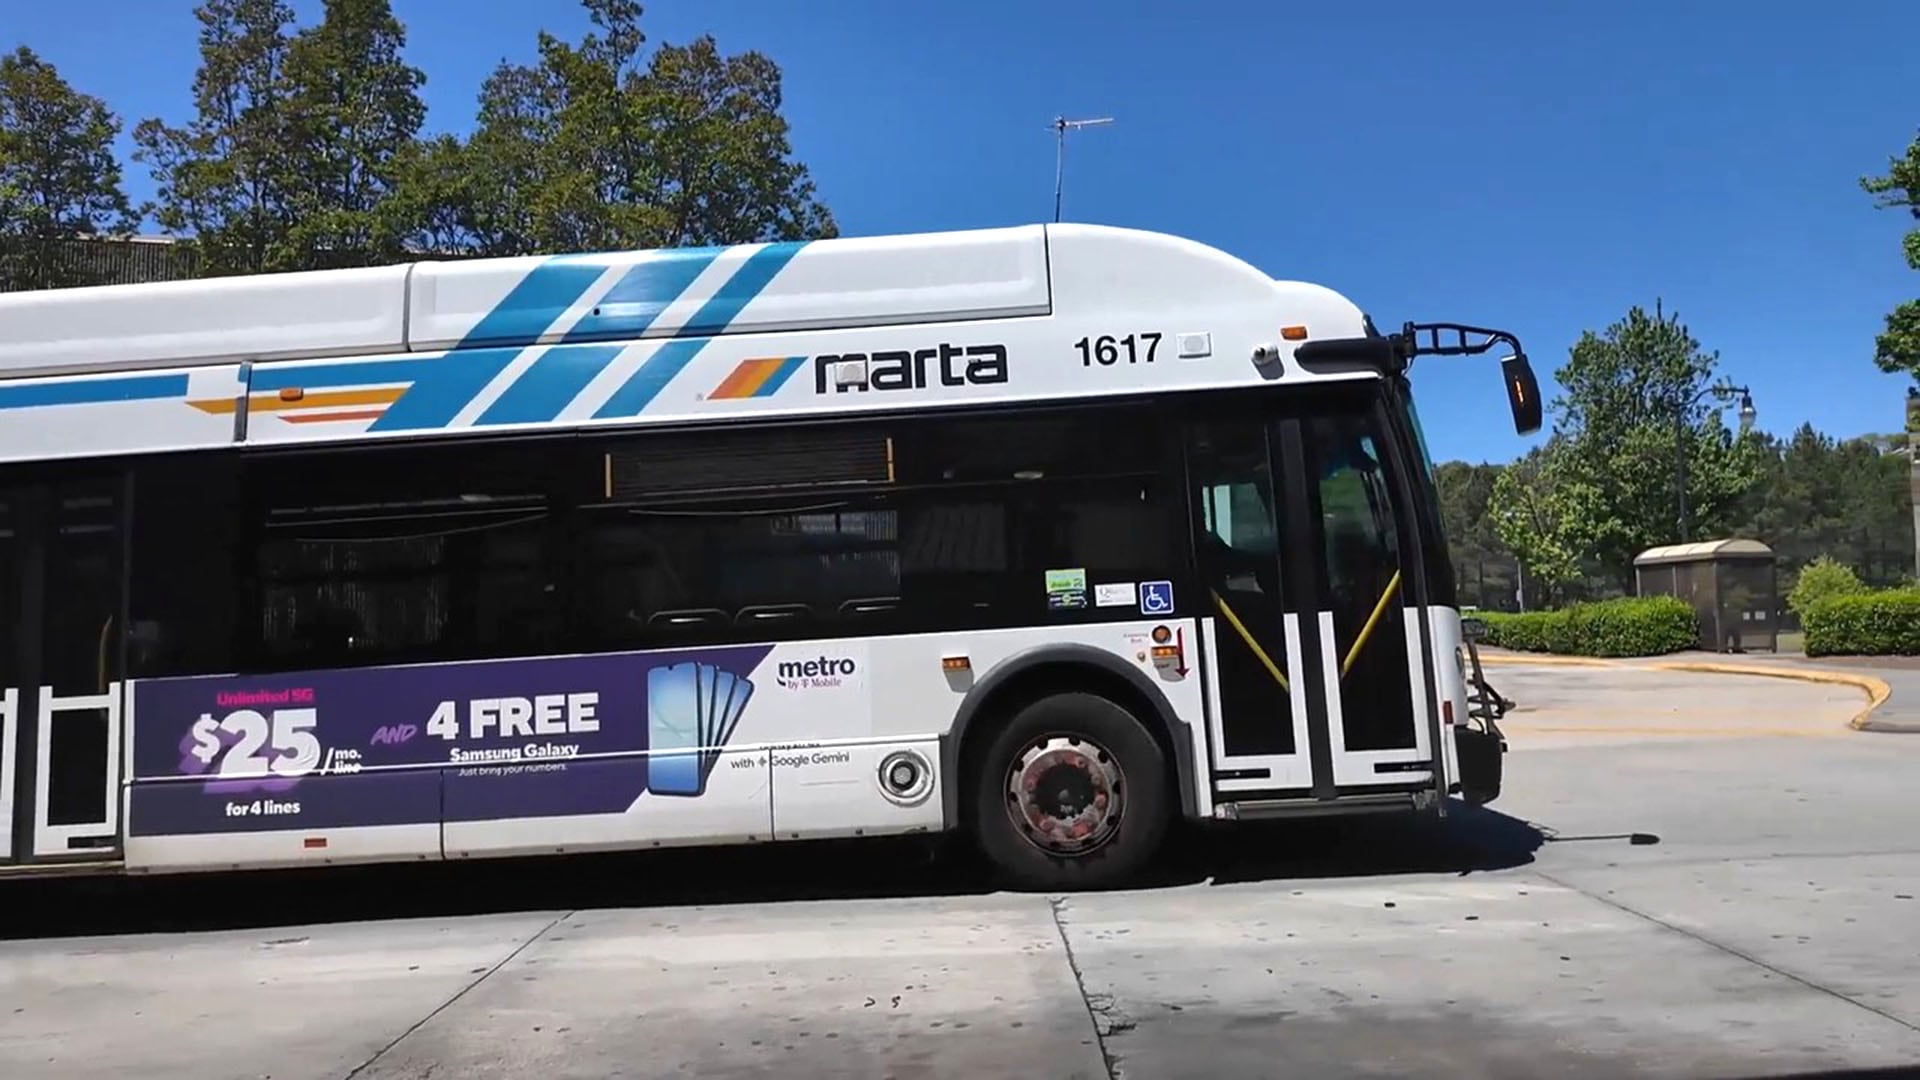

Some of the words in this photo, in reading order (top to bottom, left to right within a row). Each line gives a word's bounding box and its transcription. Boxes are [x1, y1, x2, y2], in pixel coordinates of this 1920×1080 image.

[1074, 332, 1163, 367] 1617
[814, 343, 1009, 394] marta
[778, 656, 855, 678] metro
[788, 680, 799, 691] by
[217, 689, 289, 705] Unlimited
[291, 688, 314, 701] 5G
[426, 700, 459, 740] 4
[469, 692, 600, 739] FREE
[370, 723, 418, 746] AND
[450, 747, 522, 763] Samsung
[524, 743, 579, 760] Galaxy
[730, 757, 755, 769] with
[771, 754, 809, 768] Google
[811, 751, 850, 765] Gemini
[458, 767, 478, 777] Just
[479, 766, 501, 776] bring
[502, 766, 524, 776] your
[225, 802, 249, 817] for
[250, 801, 262, 815] 4
[264, 800, 300, 815] lines
